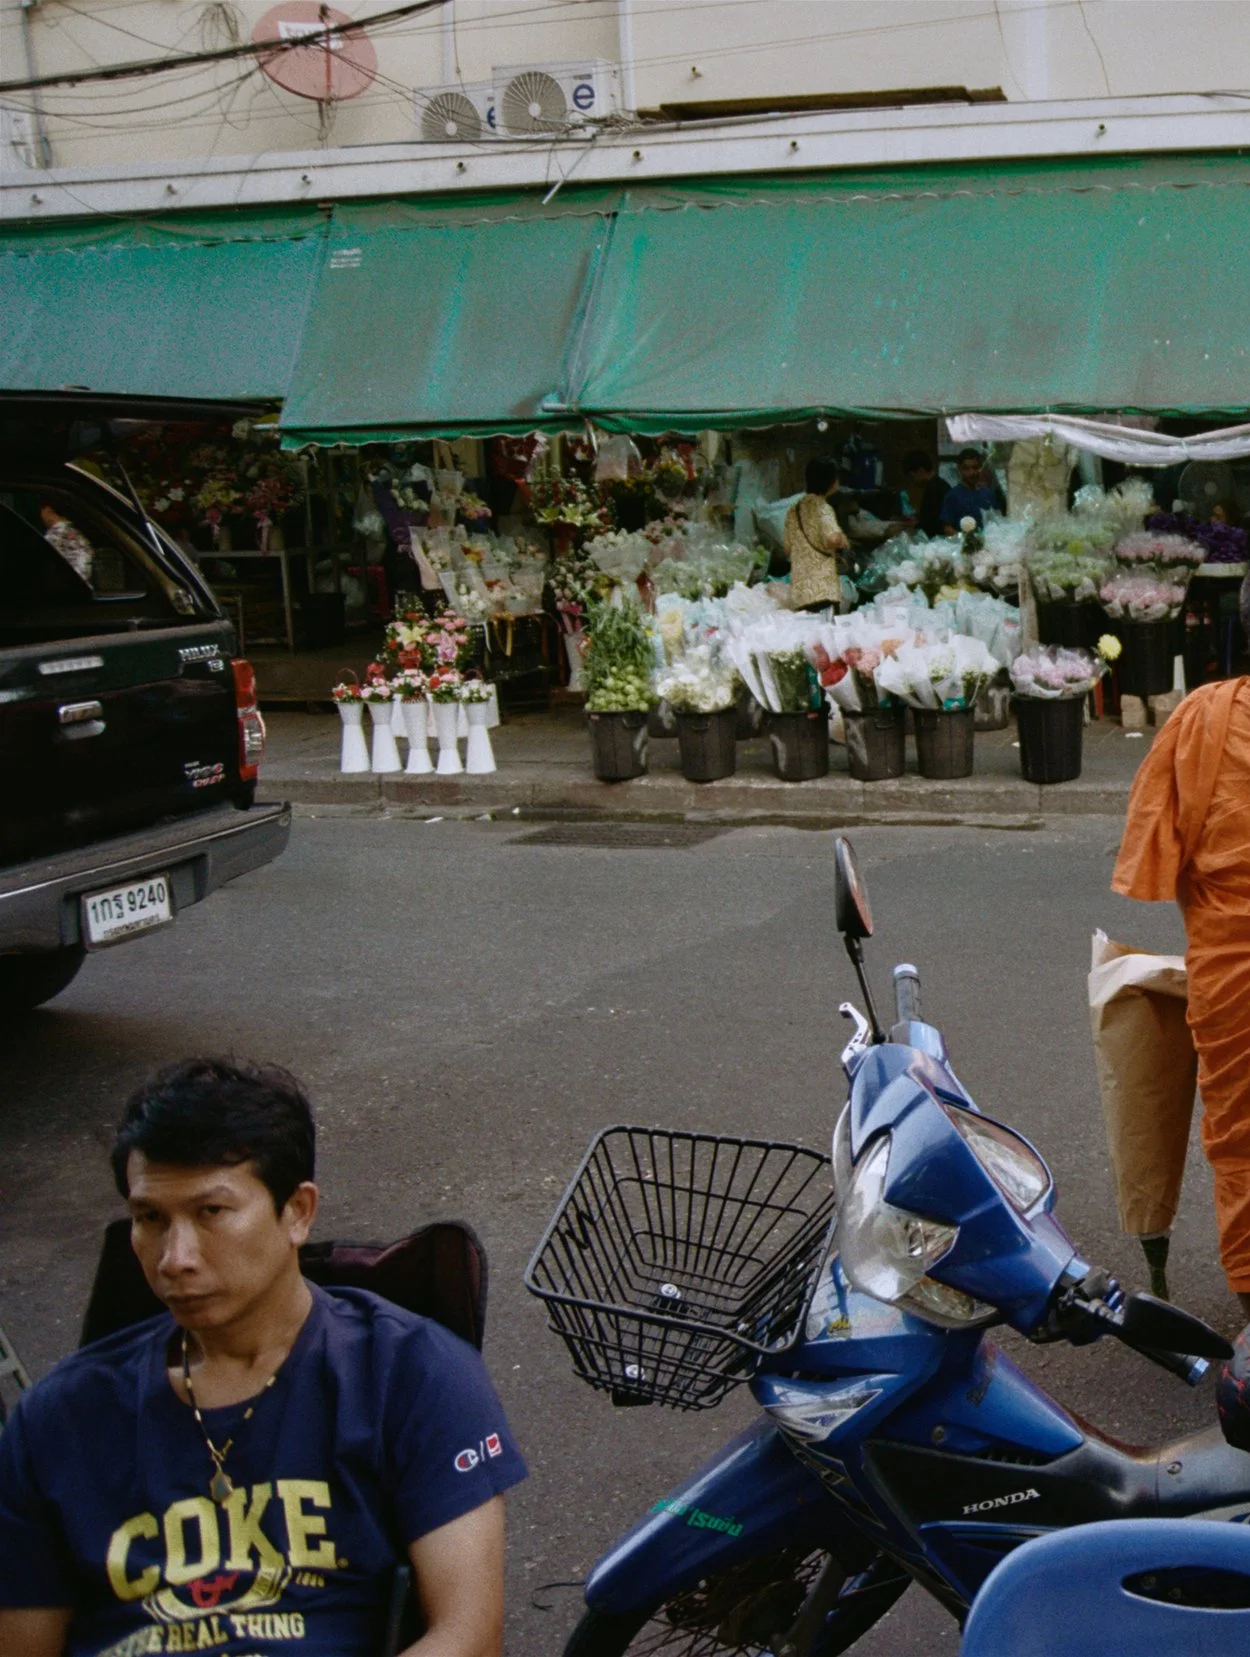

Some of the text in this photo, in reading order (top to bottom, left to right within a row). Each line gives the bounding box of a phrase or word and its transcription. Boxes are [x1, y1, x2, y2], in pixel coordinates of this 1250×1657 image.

[127, 882, 166, 912] 9240
[962, 1488, 1041, 1515] HONDA
[106, 1479, 337, 1601] COKE
[166, 1615, 229, 1652] REAL
[229, 1612, 305, 1641] THING
